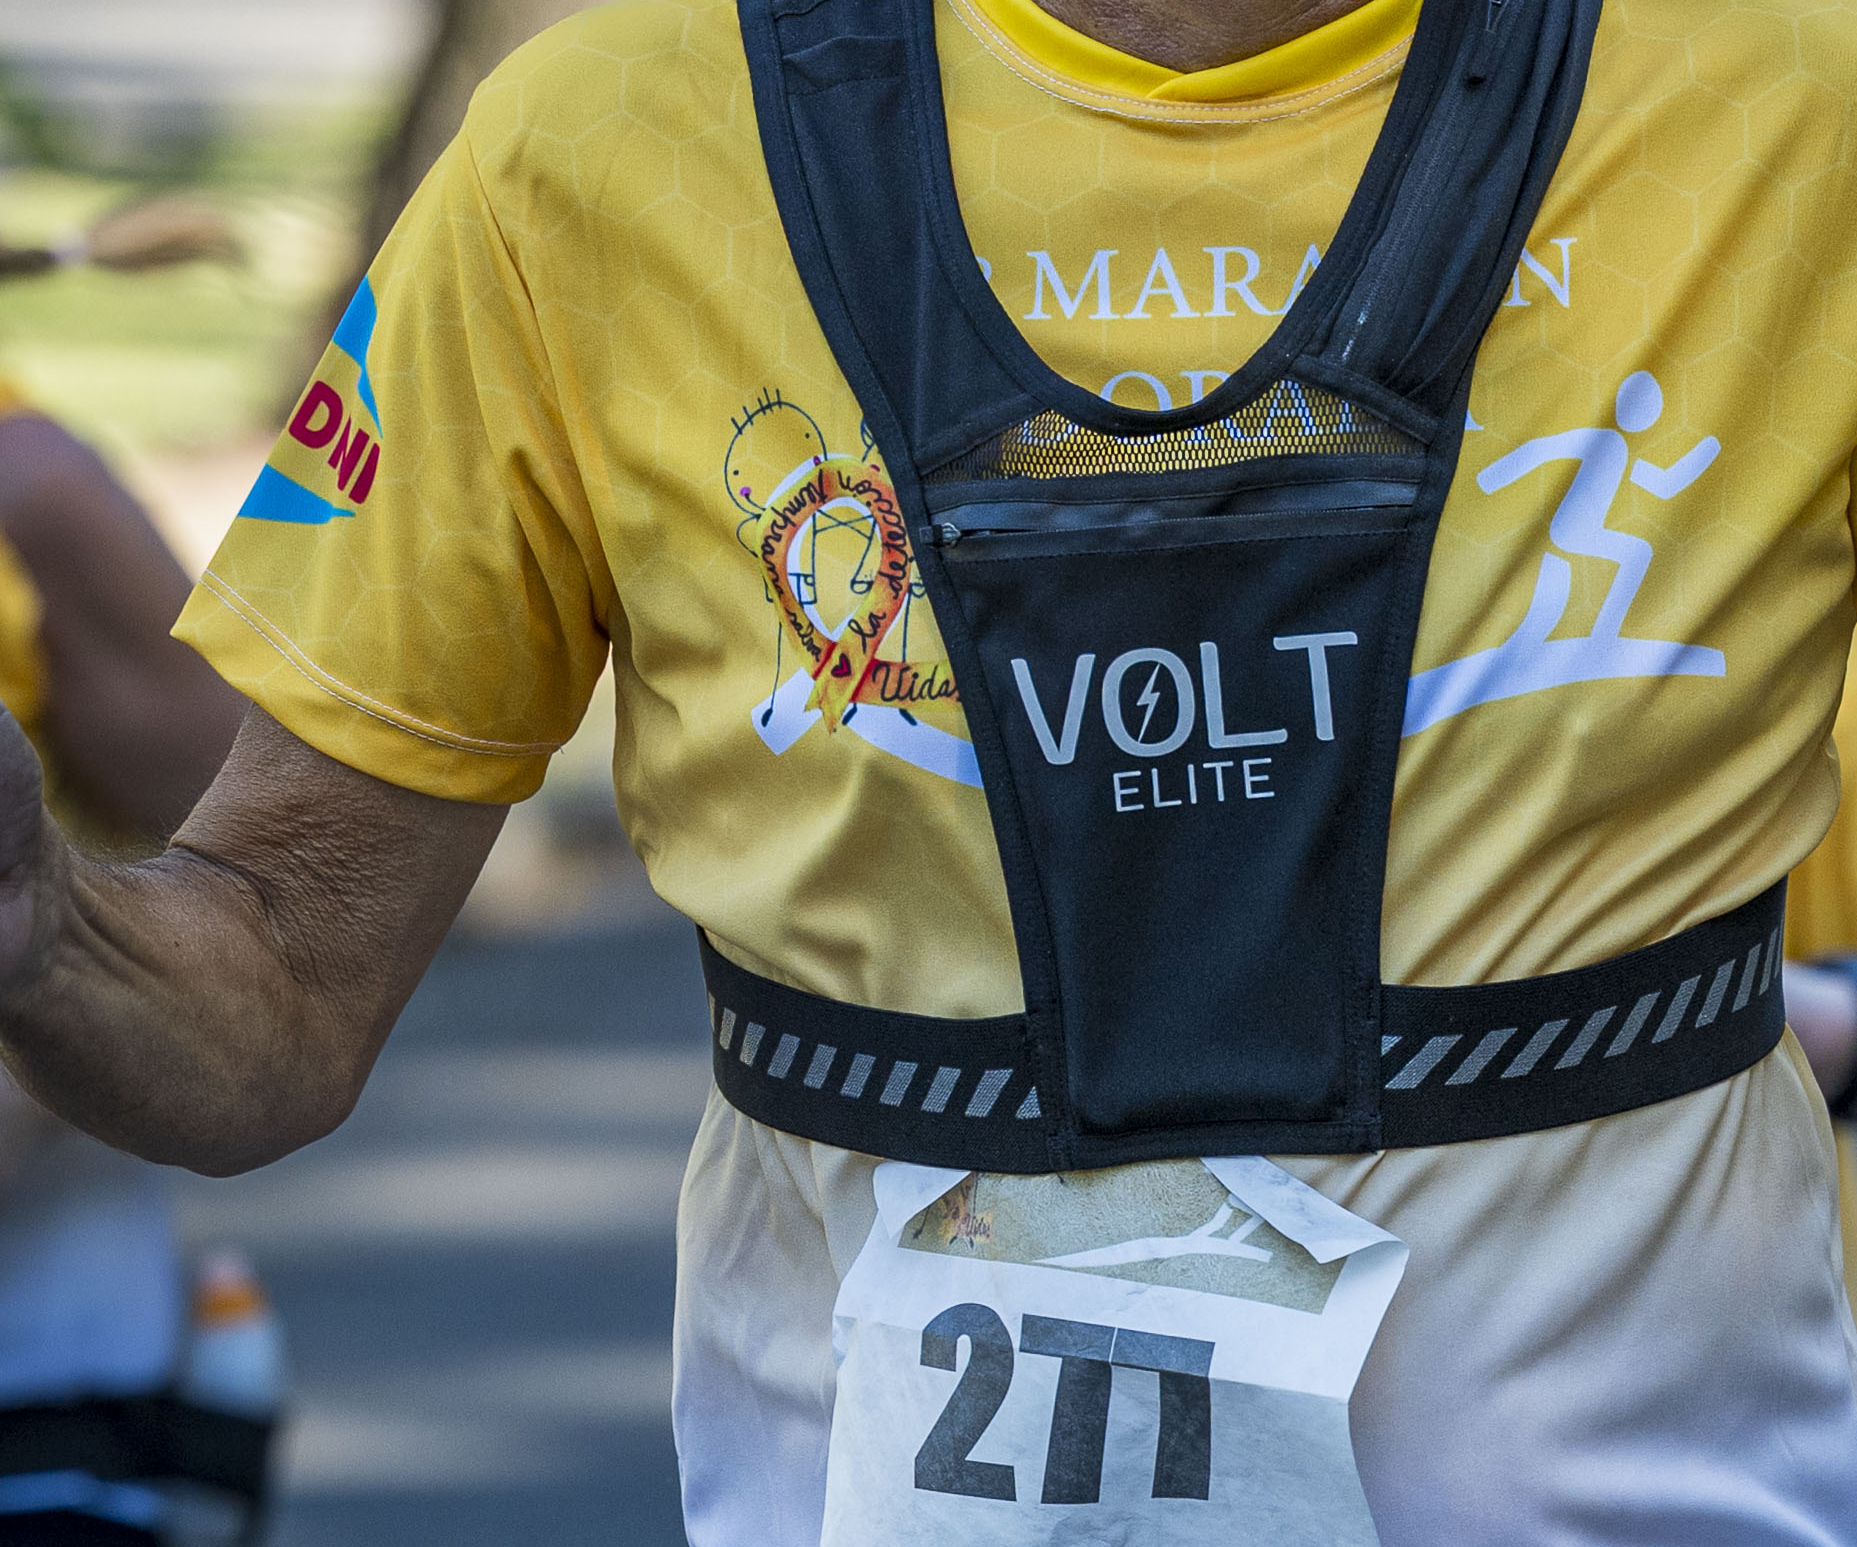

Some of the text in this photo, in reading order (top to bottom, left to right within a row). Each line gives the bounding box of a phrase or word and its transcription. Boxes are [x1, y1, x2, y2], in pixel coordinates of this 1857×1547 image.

[871, 660, 961, 703] Vida
[1011, 631, 1358, 765] VOLT
[1112, 757, 1276, 813] ELITE
[913, 1302, 1216, 1505] 277
